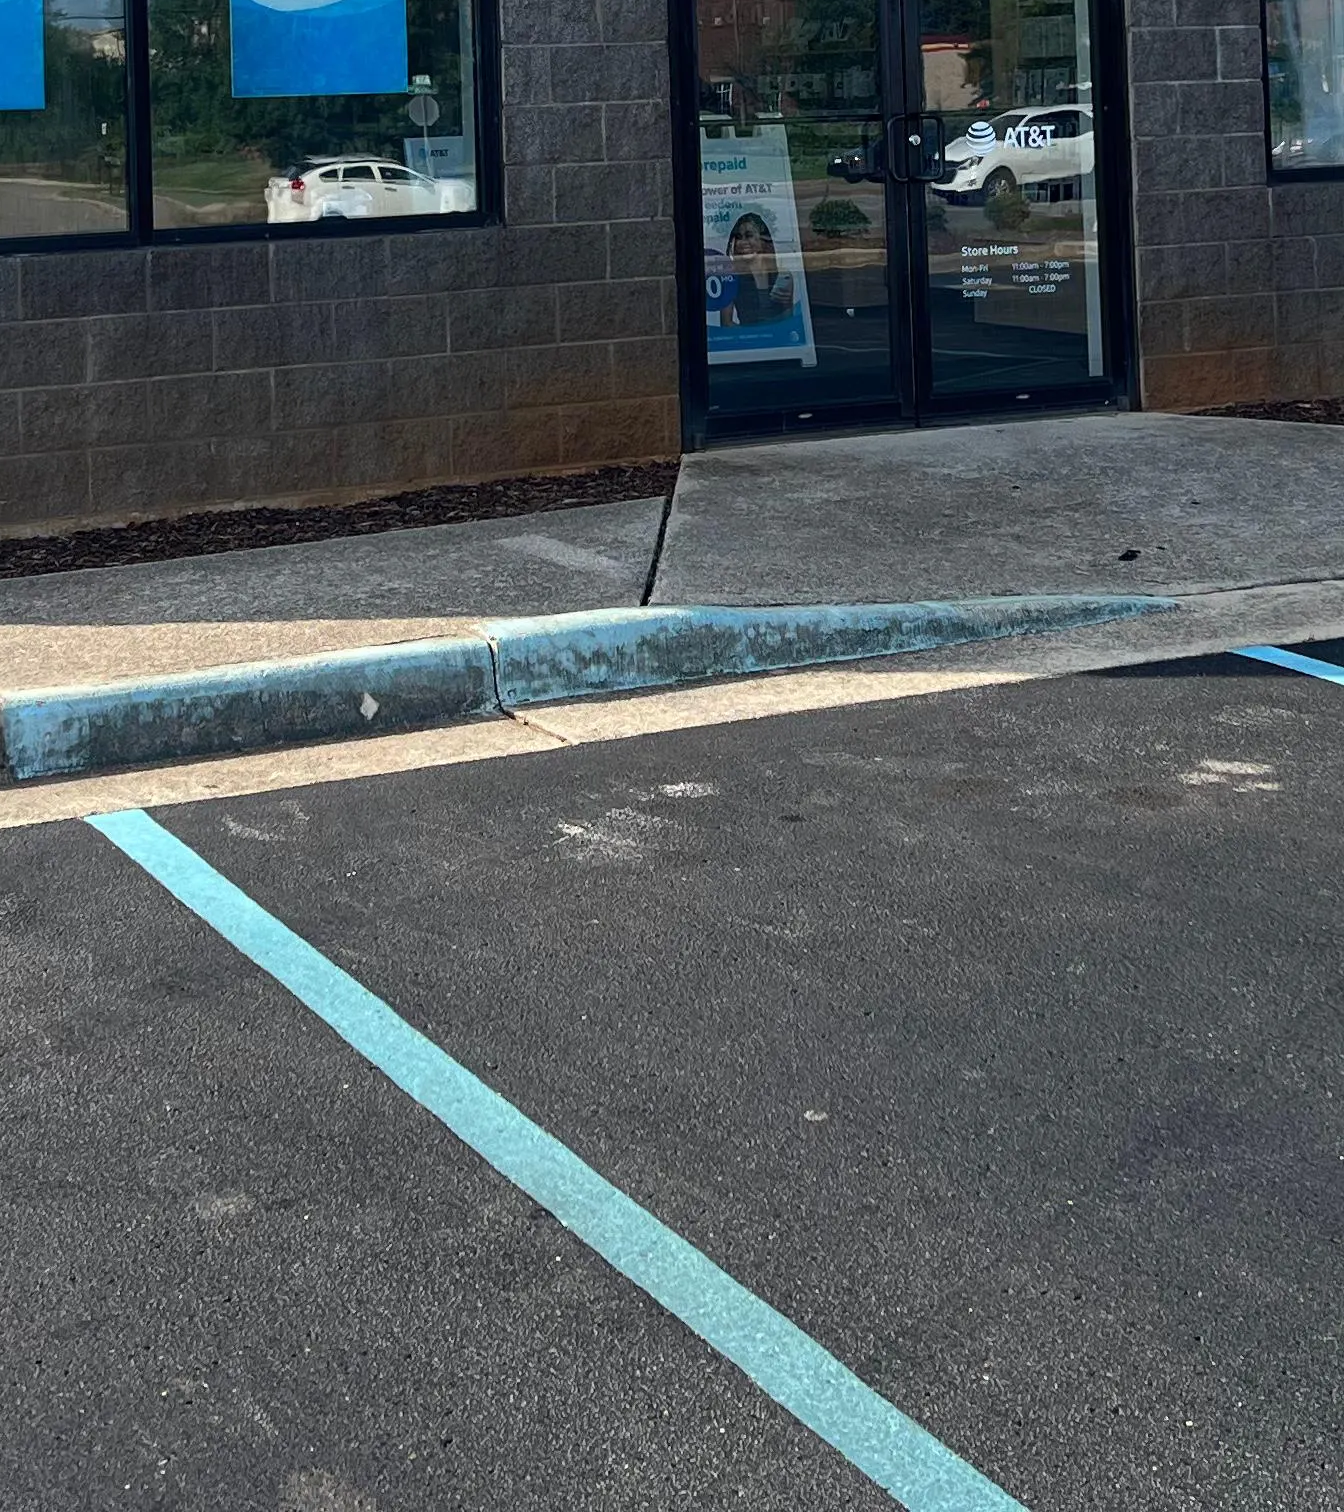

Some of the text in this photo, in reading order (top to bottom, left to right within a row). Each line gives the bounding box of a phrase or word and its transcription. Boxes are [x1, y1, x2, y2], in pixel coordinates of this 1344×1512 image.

[1004, 125, 1055, 148] AT&T
[703, 157, 747, 174] repaid
[702, 183, 773, 196] ower of AT&T
[961, 245, 1018, 257] Store Hours
[961, 264, 989, 273] Mon-Fri
[1044, 260, 1070, 270] 7:00pm
[962, 277, 993, 286] Saturday
[962, 284, 1056, 298] Sunday CLOSED
